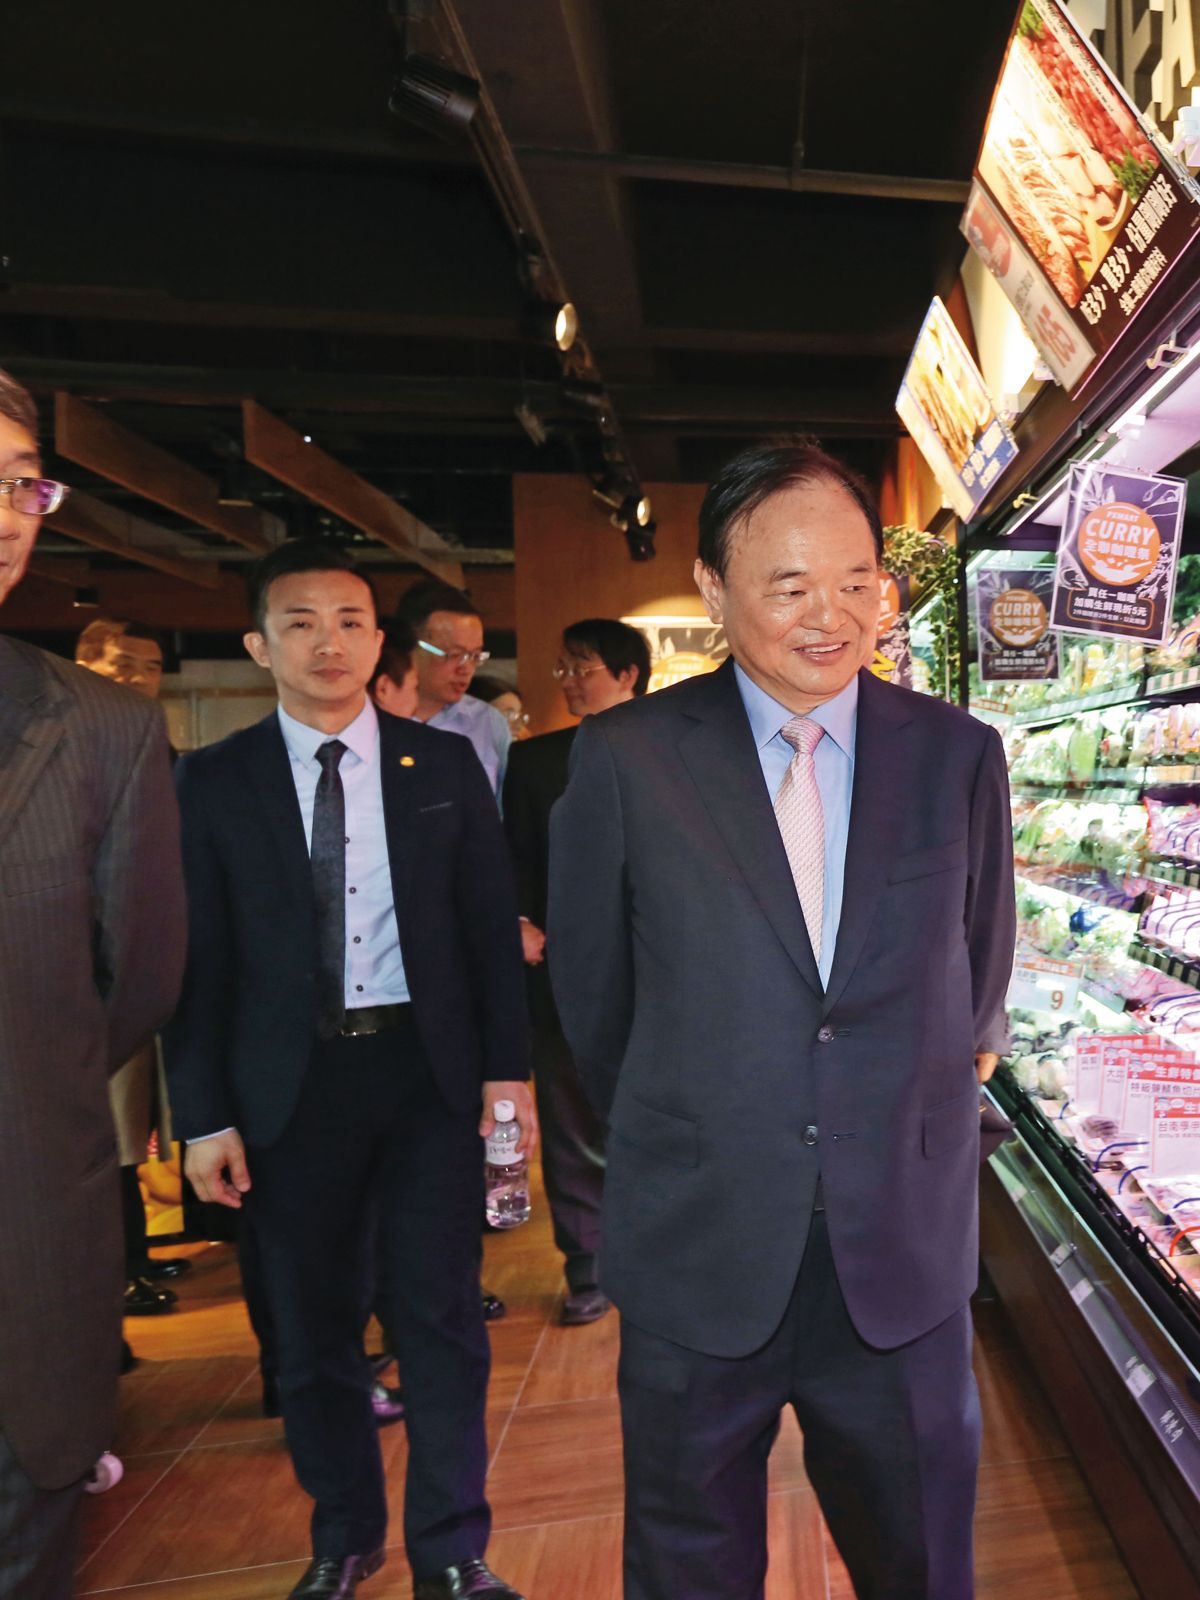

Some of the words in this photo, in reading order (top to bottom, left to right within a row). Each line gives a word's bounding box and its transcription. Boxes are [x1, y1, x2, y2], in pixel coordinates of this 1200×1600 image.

[1085, 519, 1156, 546] CURRY
[993, 602, 1042, 616] CURRY
[1050, 991, 1064, 1010] 9
